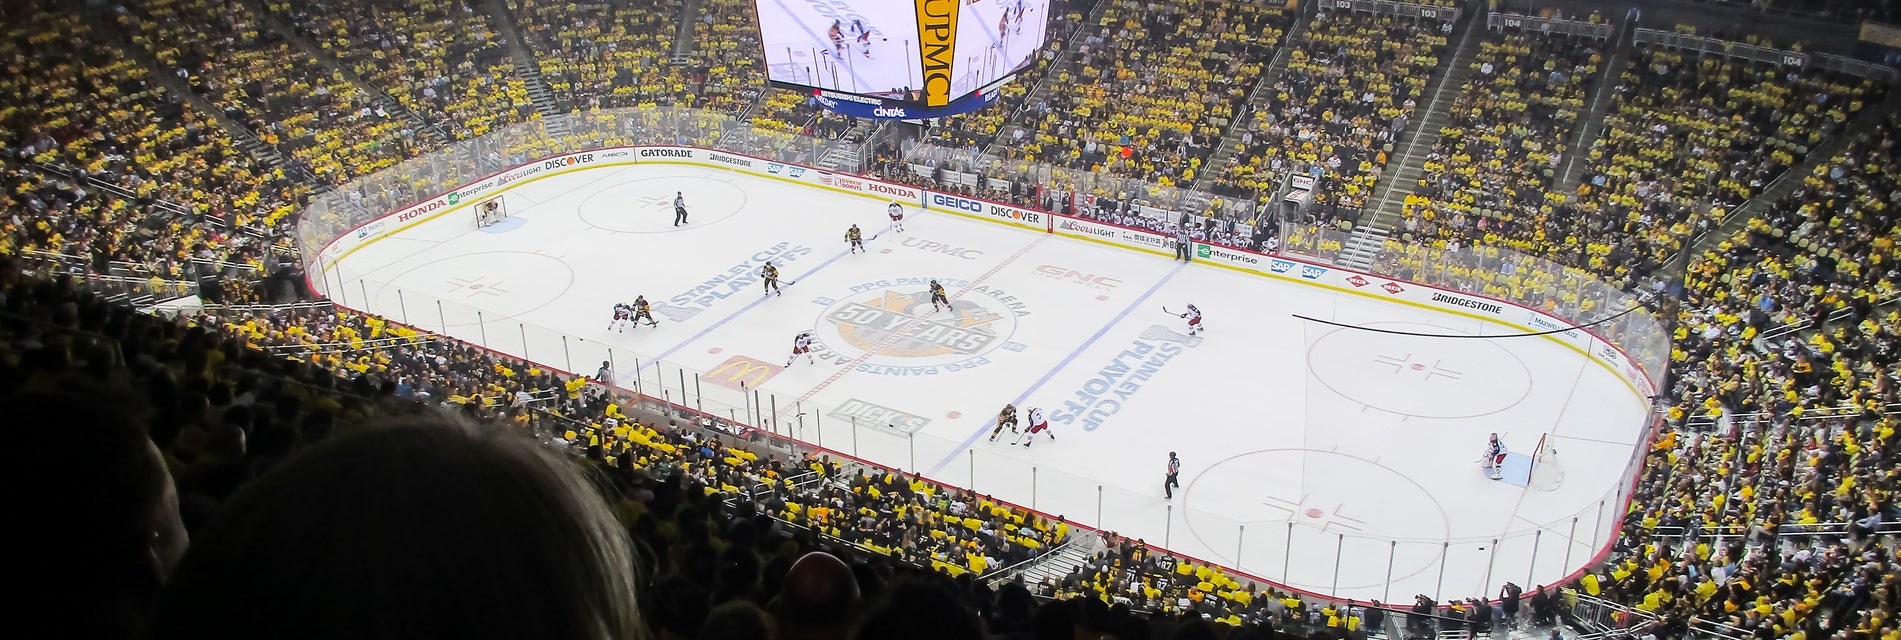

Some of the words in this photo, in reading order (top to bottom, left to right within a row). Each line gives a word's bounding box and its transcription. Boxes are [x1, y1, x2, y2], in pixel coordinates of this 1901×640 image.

[1336, 1, 1351, 9] 103
[1421, 9, 1437, 18] 103
[1504, 18, 1521, 28] 104
[924, 0, 950, 97] UPMC
[545, 153, 594, 170] DISCOVER
[640, 149, 693, 159] GATORADE
[709, 153, 752, 168] BRIDGESTONE
[523, 166, 542, 176] LIGHT
[767, 163, 782, 173] SAP
[789, 168, 803, 177] SAP
[868, 183, 917, 199] HONDA
[398, 199, 447, 223] HONDA
[933, 194, 982, 213] GEICO
[990, 205, 1040, 224] DISCOVER
[1069, 220, 1093, 234] Coors
[1093, 227, 1116, 238] LIGHT
[901, 237, 984, 260] UPMC
[1199, 246, 1258, 265] enterprise
[670, 260, 753, 306] STANLEY
[752, 241, 789, 263] CUP
[1271, 260, 1290, 272] SAP
[1303, 266, 1322, 278] SAP
[849, 279, 891, 293] PPG
[977, 285, 1032, 318] ARENA
[1431, 292, 1503, 315] BRIDGESTONE
[834, 304, 883, 325] 50
[885, 317, 988, 351] YEARS
[855, 362, 939, 376] PAINTS
[945, 356, 991, 372] PPG
[1113, 342, 1182, 401] STANLEY
[1050, 340, 1156, 426] PLAYOFFS
[1081, 398, 1121, 432] CUP
